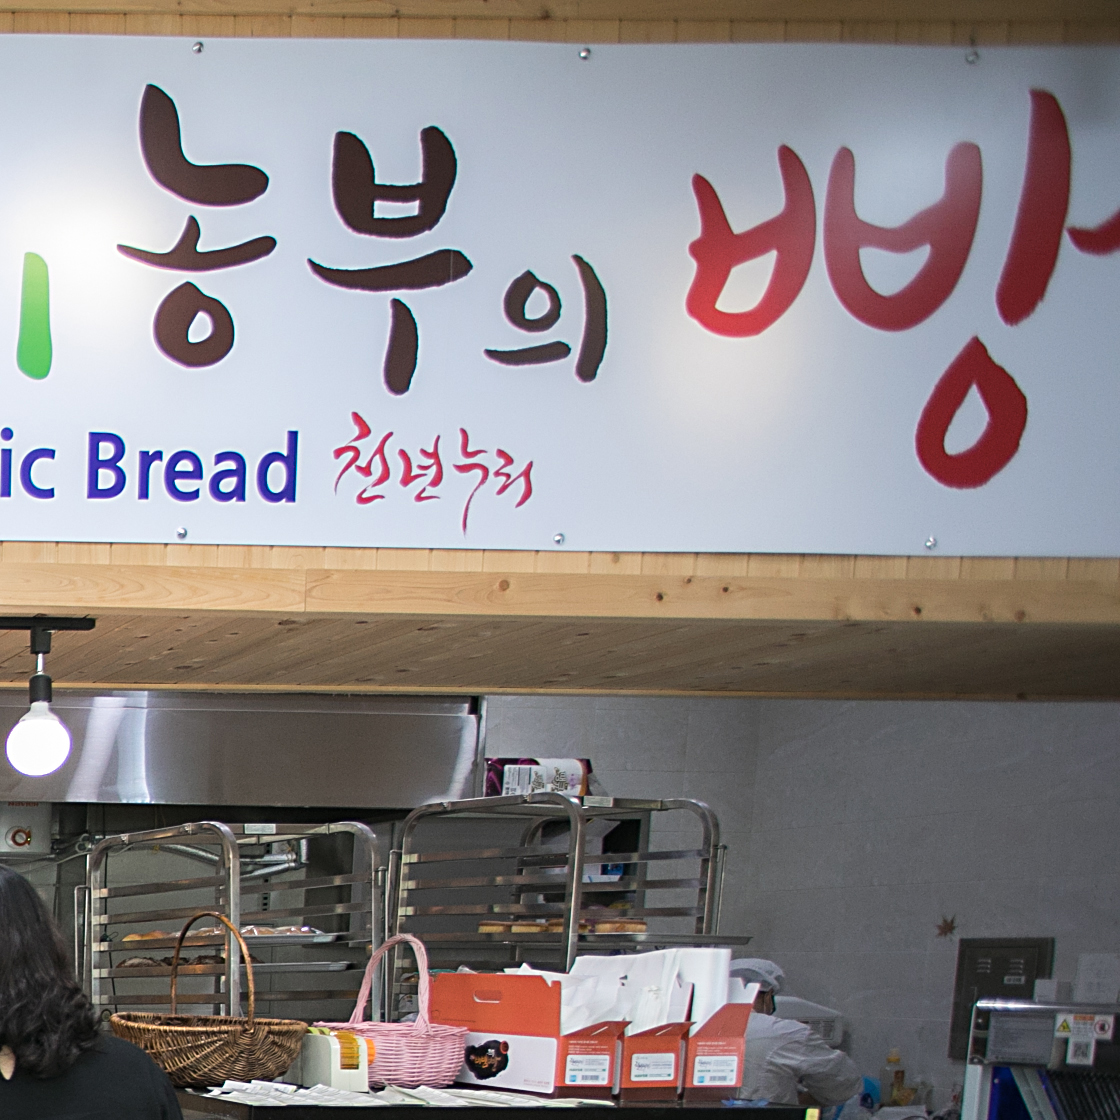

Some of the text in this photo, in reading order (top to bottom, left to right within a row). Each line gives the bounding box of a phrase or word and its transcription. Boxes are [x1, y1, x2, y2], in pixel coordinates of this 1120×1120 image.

[117, 83, 609, 396] 농부의
[686, 88, 1120, 490] 빵
[87, 430, 299, 504] Bread
